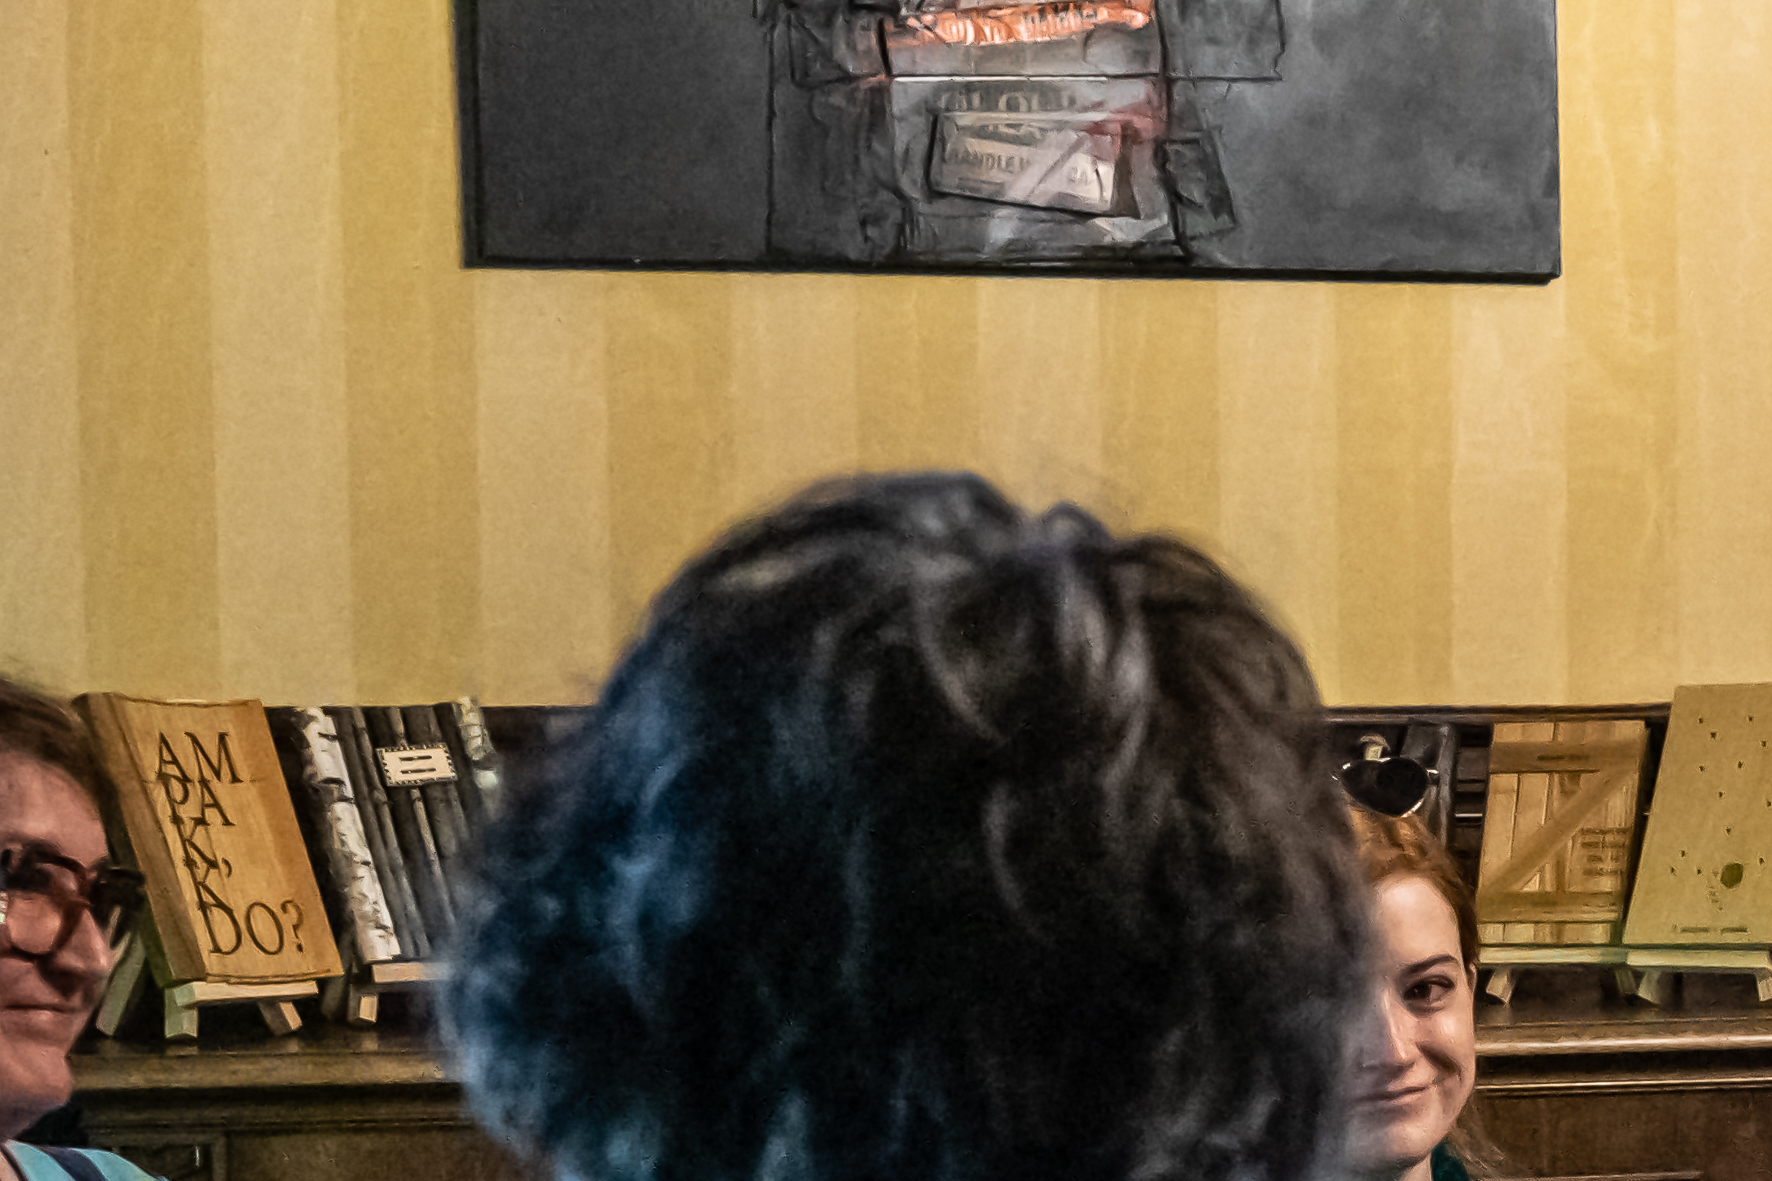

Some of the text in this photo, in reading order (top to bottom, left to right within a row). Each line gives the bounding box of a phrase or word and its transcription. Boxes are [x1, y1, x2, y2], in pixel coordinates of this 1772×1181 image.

[156, 731, 244, 783] AM
[155, 772, 236, 826] PA
[199, 899, 304, 956] DO?
